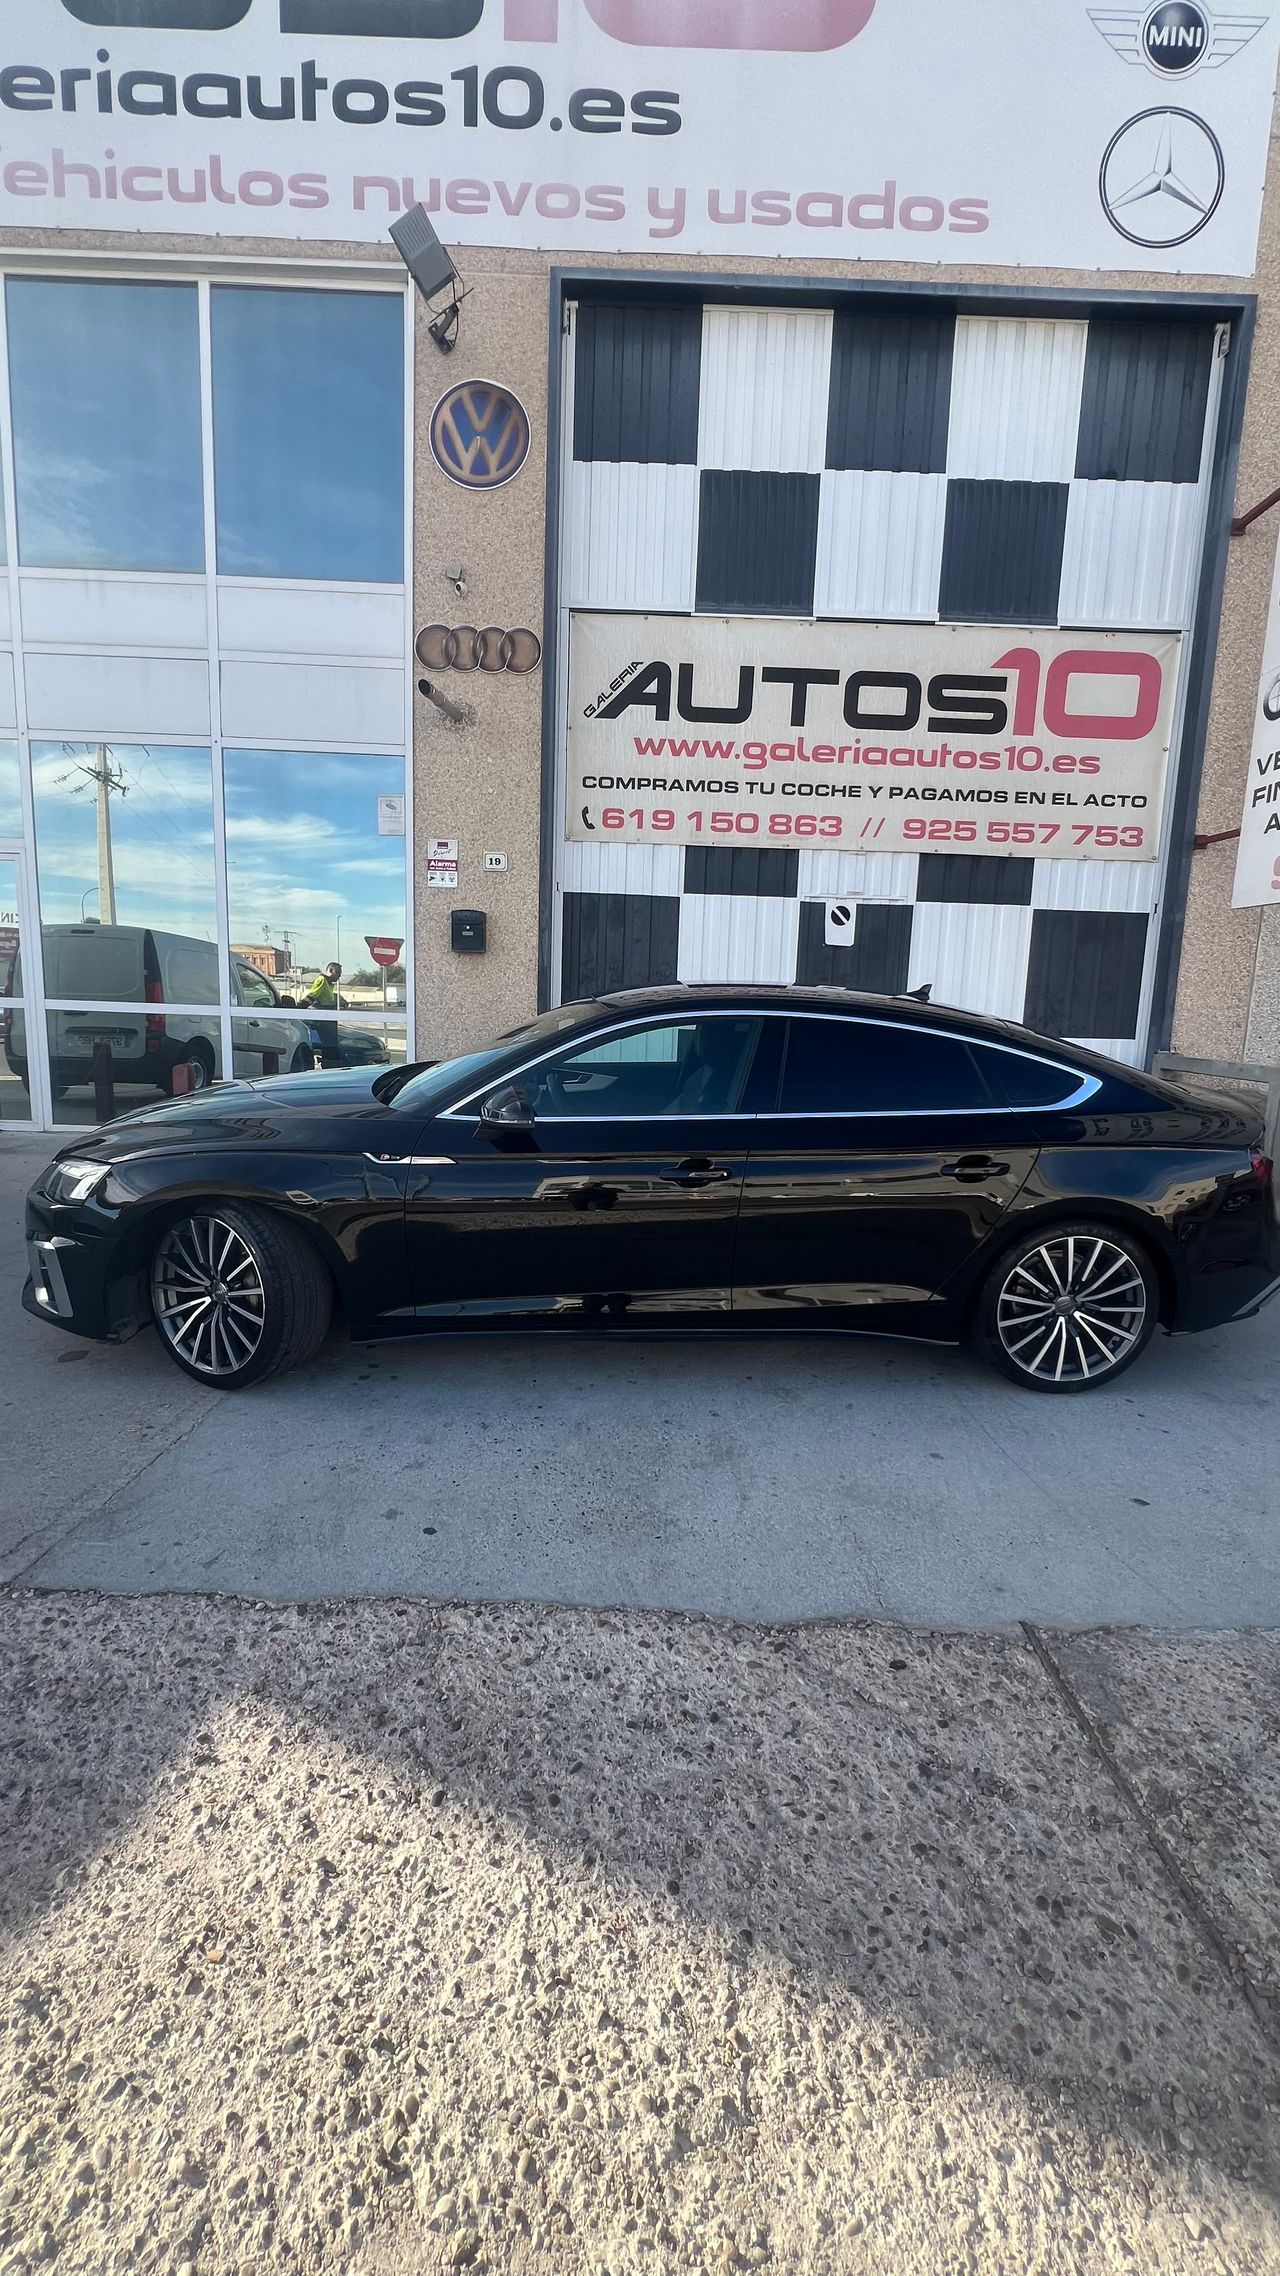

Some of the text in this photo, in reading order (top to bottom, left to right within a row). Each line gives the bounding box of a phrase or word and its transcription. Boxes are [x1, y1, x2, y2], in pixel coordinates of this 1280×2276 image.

[1149, 24, 1203, 49] MINI
[0, 147, 990, 238] ehiculos nuevos y usados
[583, 661, 644, 718] GALERIA
[633, 737, 1101, 775] www.galeriaautos10.es
[582, 775, 1148, 809] COMPRAMOS TU COCHE Y PAGAMOS EN EL ACTO
[601, 807, 677, 832] 619
[687, 810, 761, 835] 150
[768, 812, 843, 838] 863
[902, 818, 978, 843] 925
[986, 821, 1062, 846] 557
[1071, 824, 1144, 849] 753
[488, 857, 502, 866] 19
